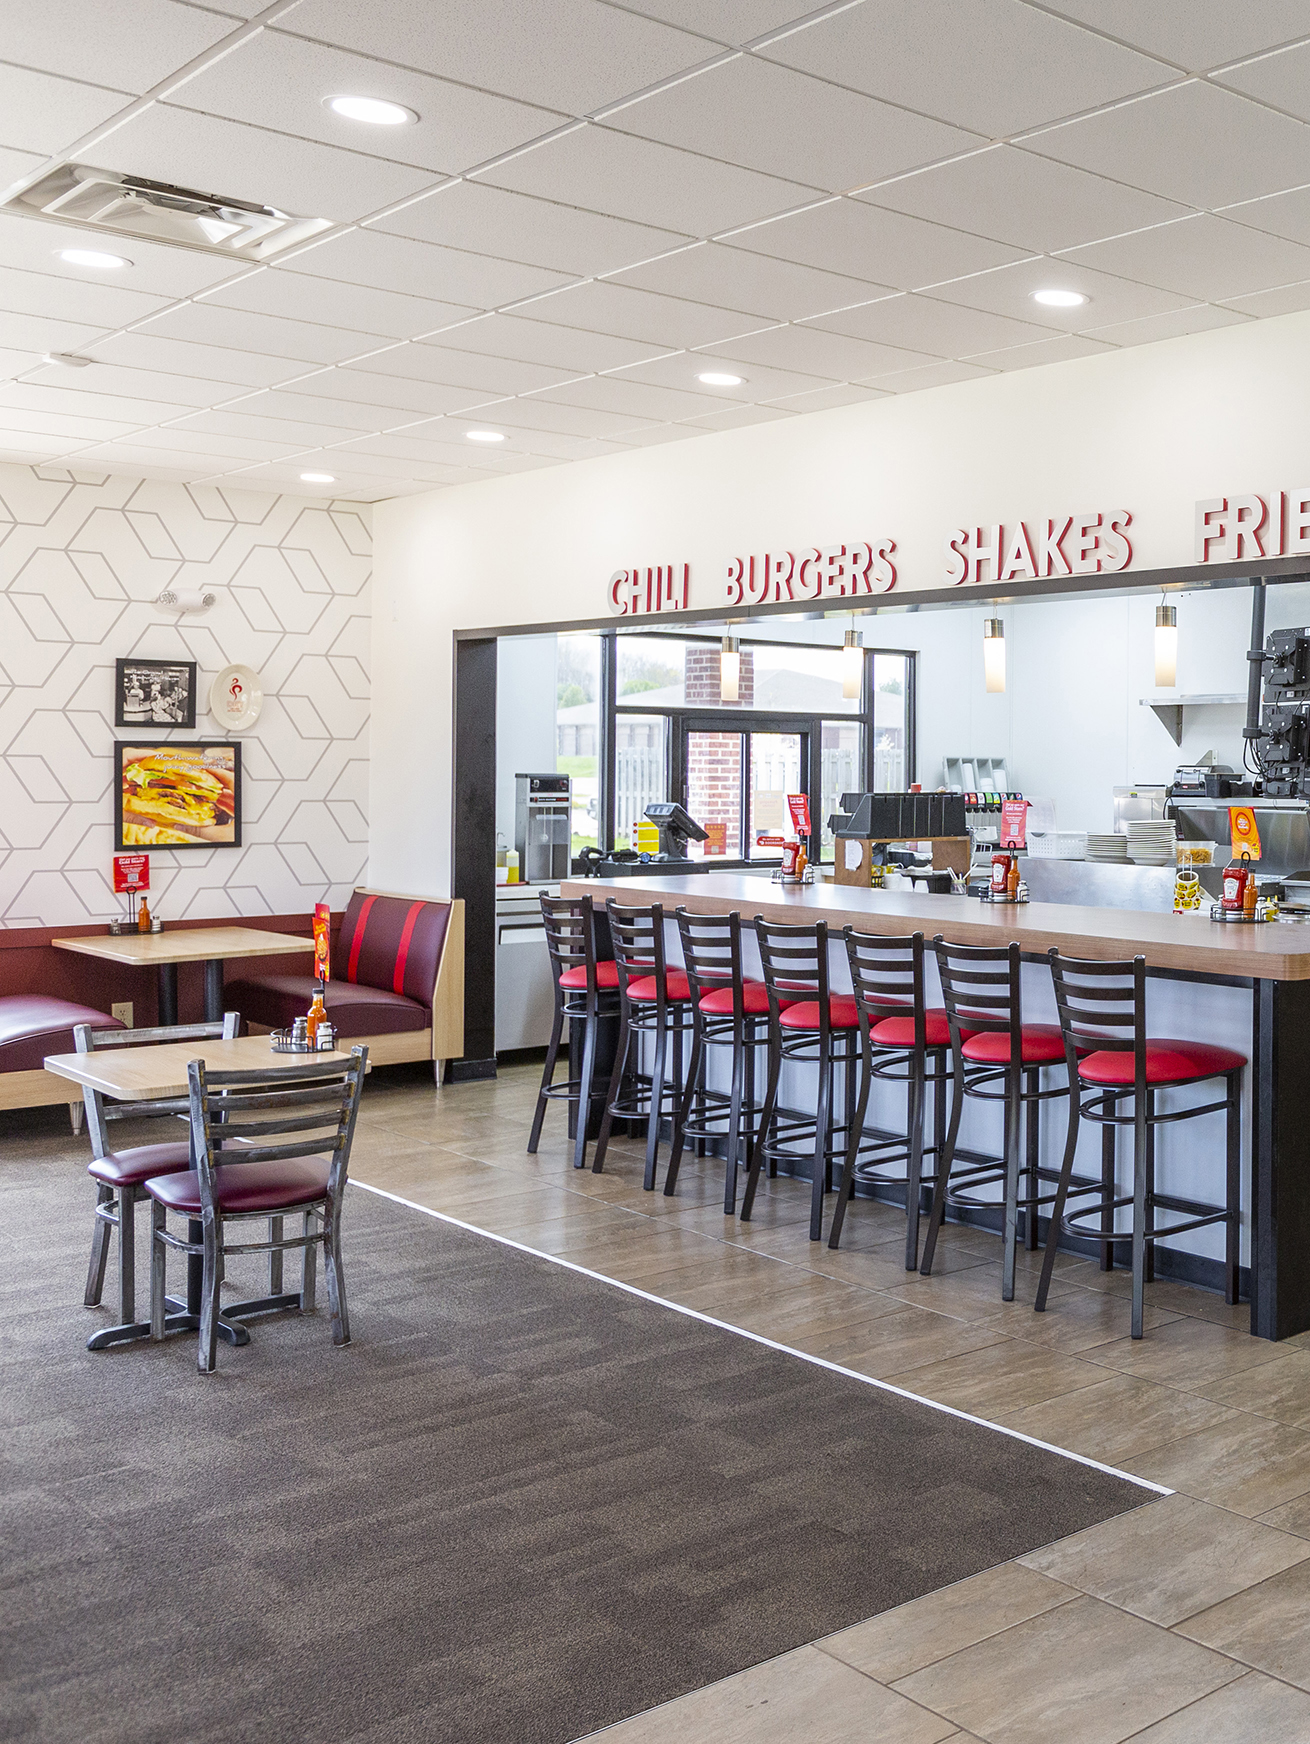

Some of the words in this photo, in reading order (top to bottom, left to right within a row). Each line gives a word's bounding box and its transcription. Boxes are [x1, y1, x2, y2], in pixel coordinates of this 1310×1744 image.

[607, 562, 690, 615] CHILI
[725, 538, 898, 605] BURGERS
[942, 509, 1134, 586] SHAKES
